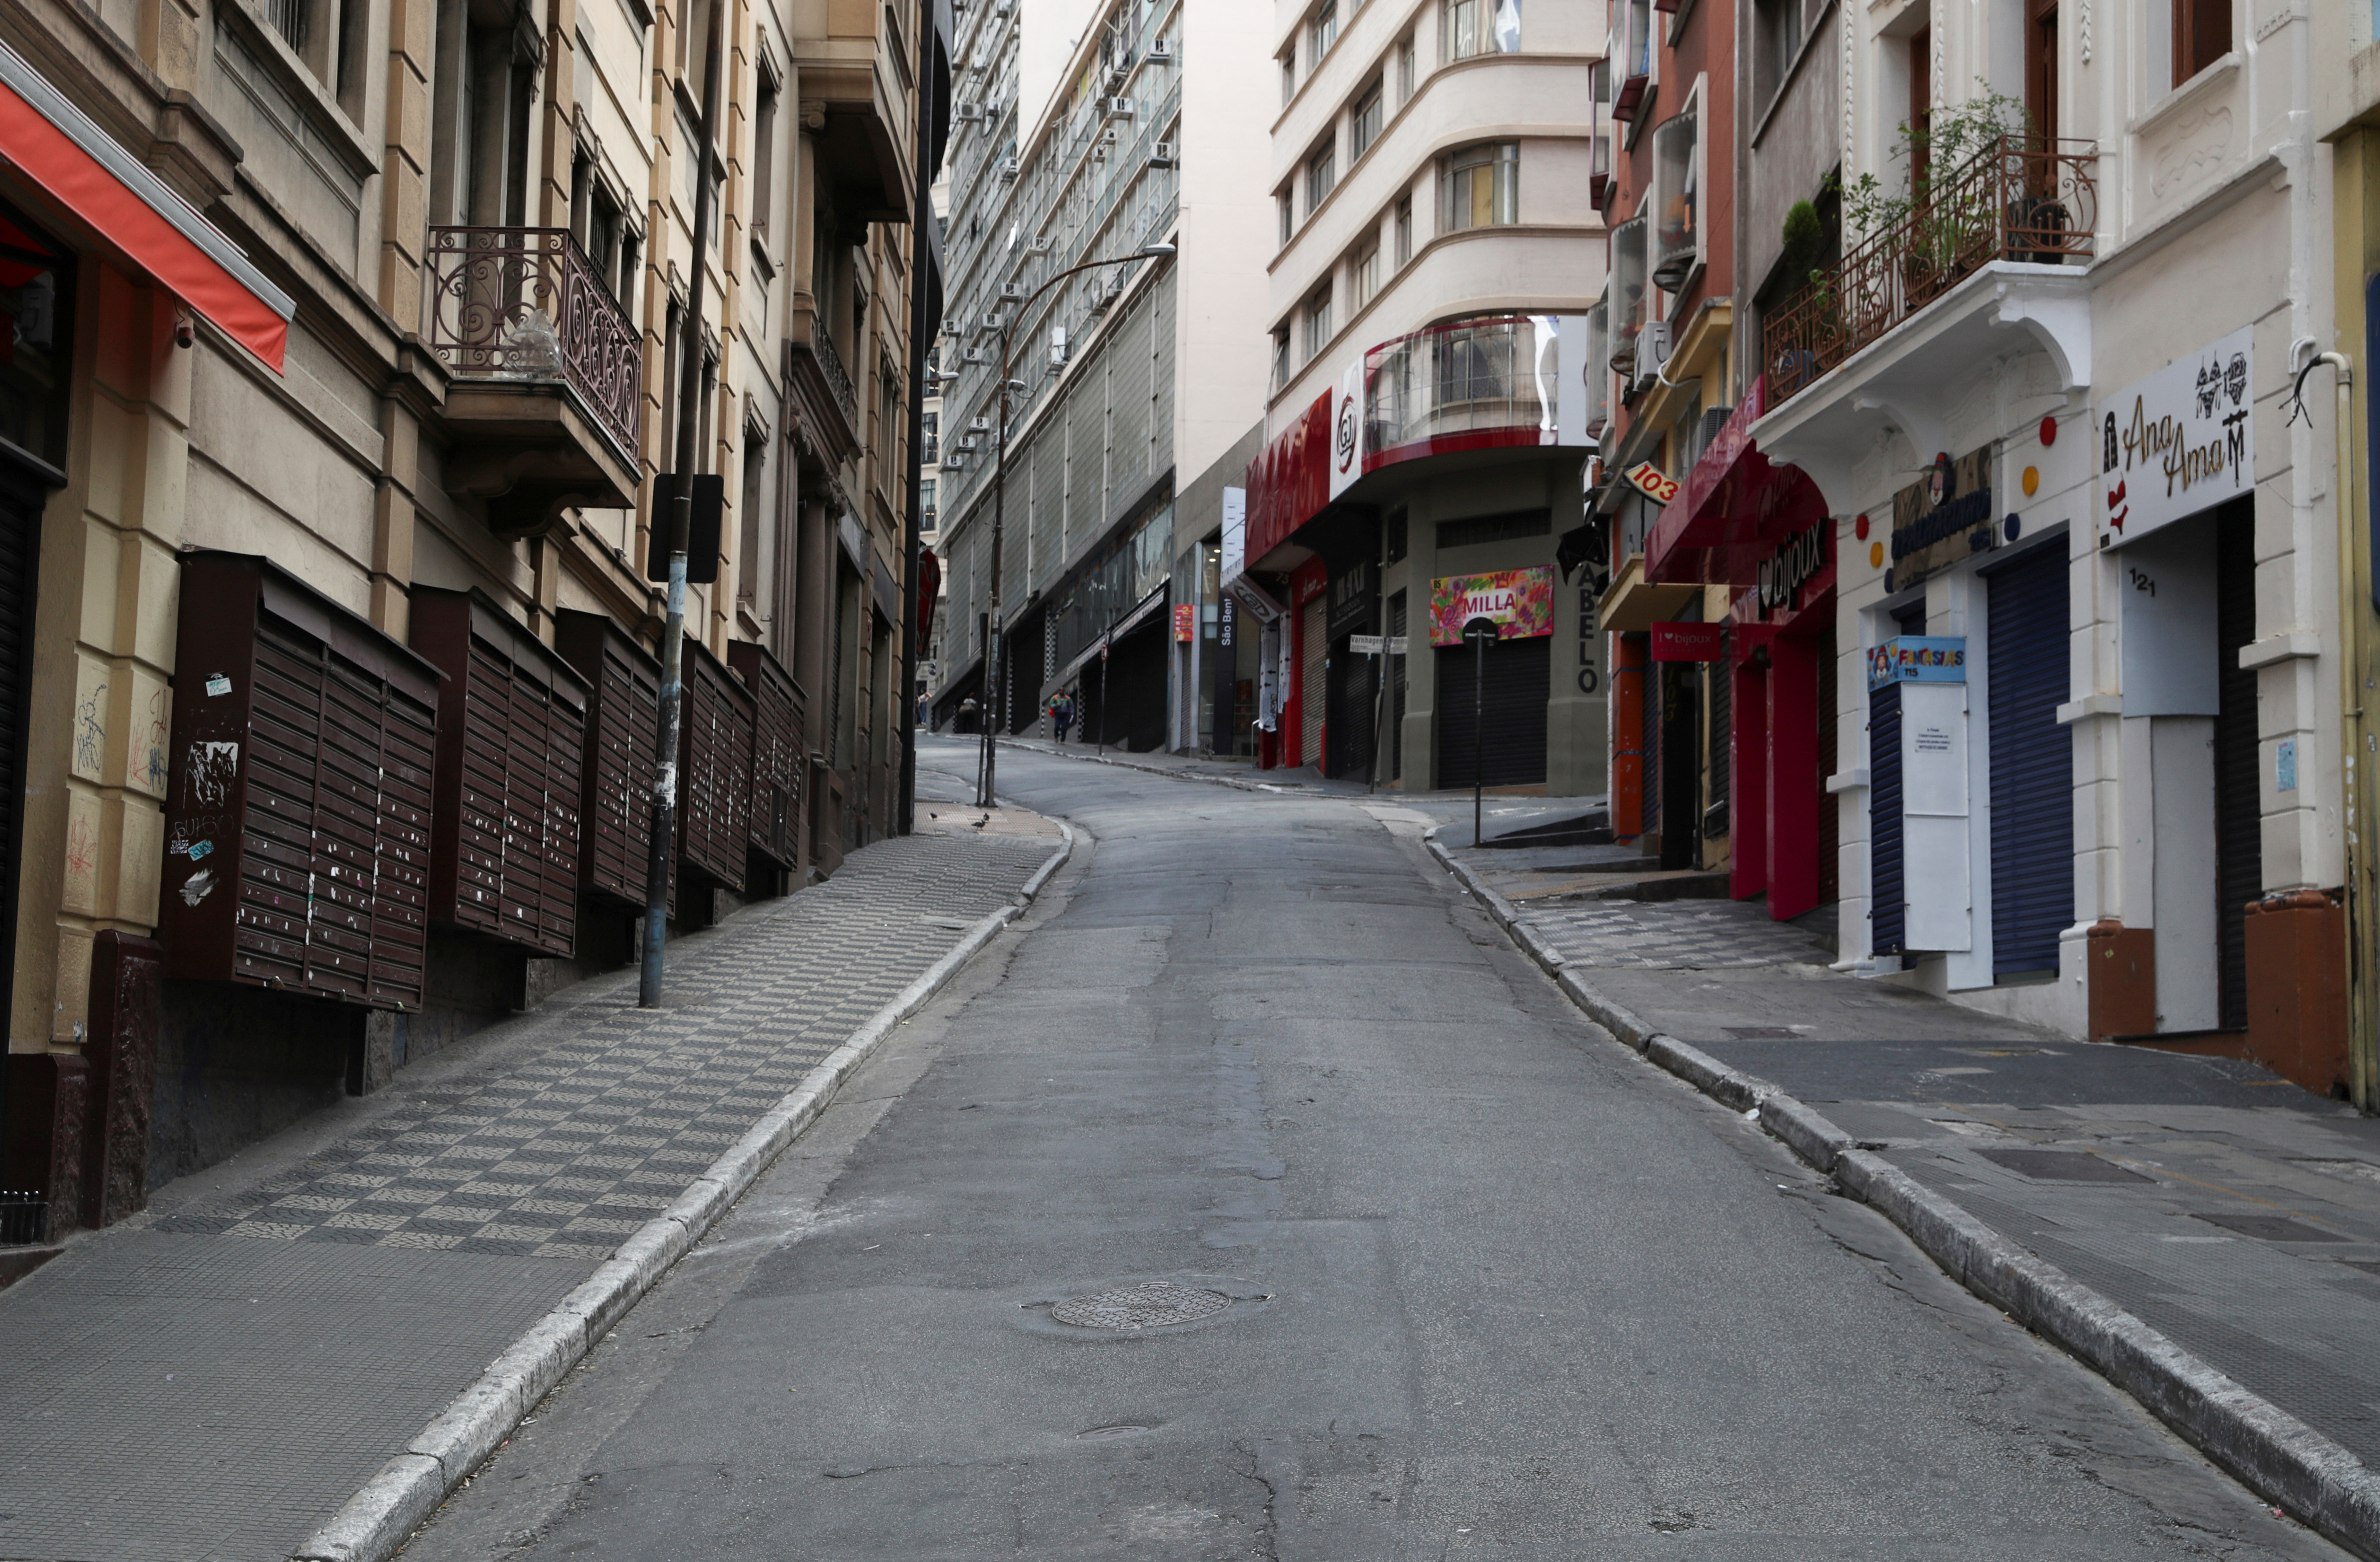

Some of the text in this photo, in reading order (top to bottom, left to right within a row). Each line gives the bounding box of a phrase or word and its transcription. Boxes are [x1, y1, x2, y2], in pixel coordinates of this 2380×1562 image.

[2122, 394, 2175, 472] Ana
[2163, 421, 2225, 497] Ama
[1633, 464, 1678, 501] 103
[1774, 518, 1828, 612] bijoux
[2129, 567, 2156, 597] 121
[1463, 593, 1516, 614] MILLA
[1222, 598, 1232, 645] São Bent
[1675, 632, 1712, 646] bijoux
[1899, 648, 1964, 667] FANTASIAS
[1905, 668, 1918, 677] 115
